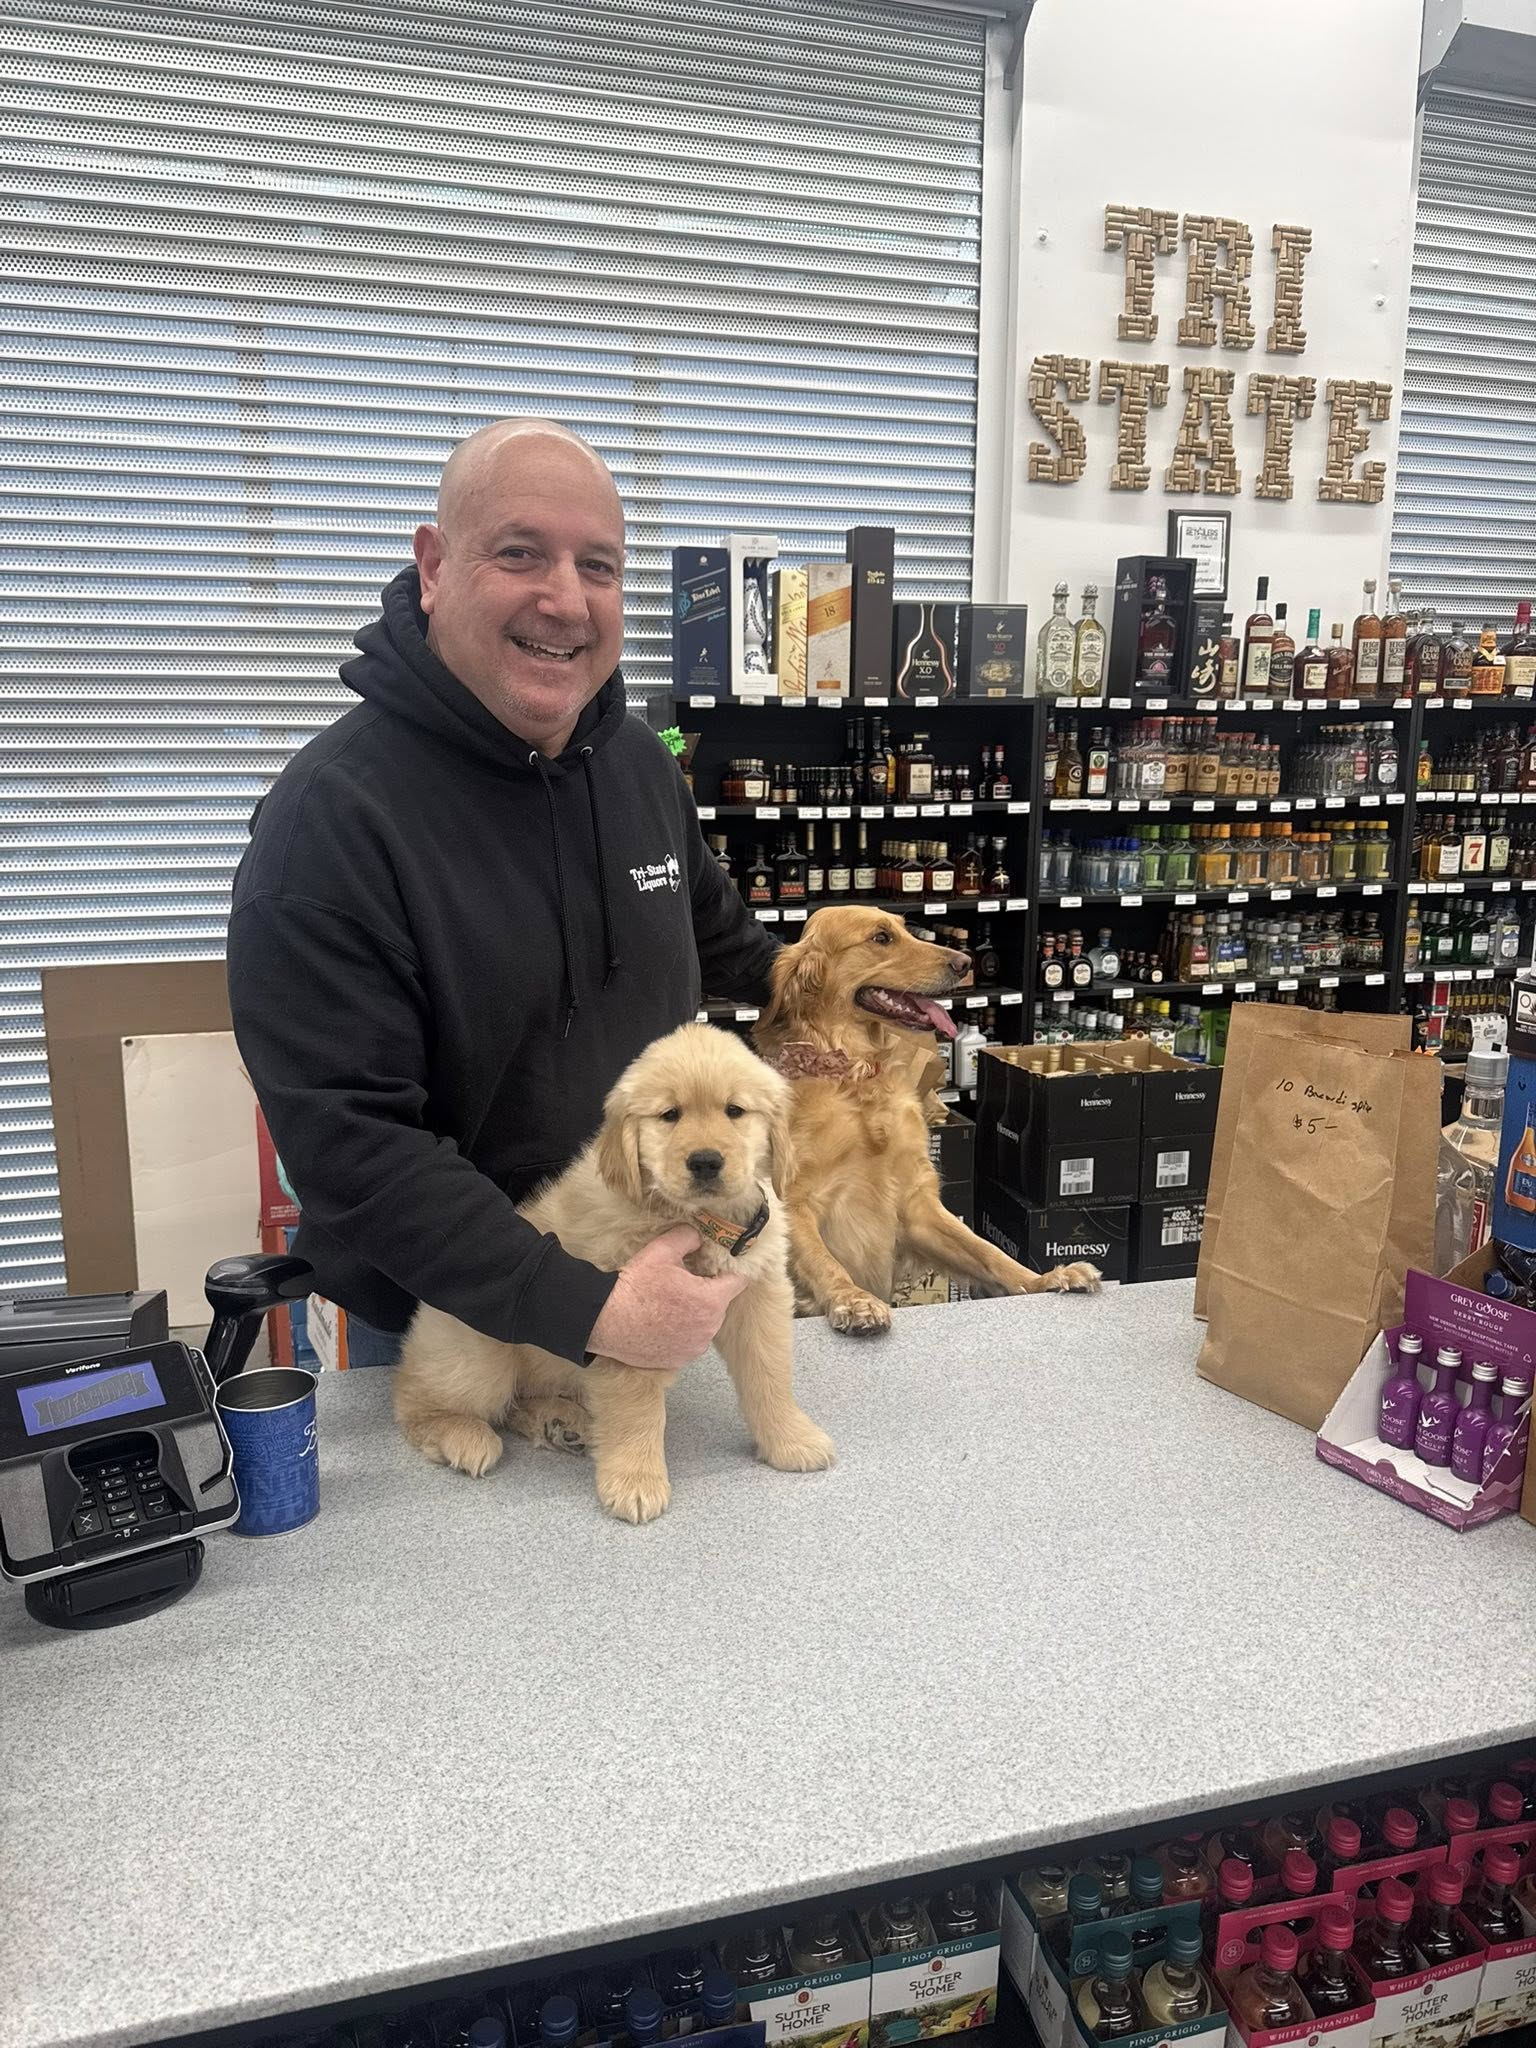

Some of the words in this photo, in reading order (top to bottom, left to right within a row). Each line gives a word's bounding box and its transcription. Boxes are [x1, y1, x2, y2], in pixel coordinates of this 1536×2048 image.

[1103, 203, 1312, 354] TRI
[1027, 354, 1393, 502] STATE
[824, 605, 836, 618] 18
[911, 658, 940, 667] Hennessy
[1469, 842, 1483, 864] 7
[629, 864, 667, 881] Tri-State
[636, 876, 668, 892] Liquors
[1275, 1078, 1294, 1092] 10
[1080, 1098, 1113, 1107] Hennessy
[1175, 1091, 1206, 1101] Hennessy
[996, 1121, 1019, 1145] Hennessy
[982, 1210, 1020, 1260] Hennessy
[1046, 1240, 1111, 1257] Hennessy
[1450, 1293, 1475, 1308] GREY
[1475, 1302, 1511, 1321] GOOSE
[1453, 1309, 1476, 1322] BERRY
[1479, 1320, 1504, 1333] ROUGE
[65, 1362, 101, 1375] Verifone
[54, 1374, 133, 1421] WELCOME
[1422, 1431, 1450, 1443] GOOSE
[902, 1951, 933, 1964] PINOT
[936, 1942, 973, 1955] GRIGIO
[1505, 1942, 1534, 1955] WHITE
[767, 1982, 799, 1995] PINOT
[804, 1972, 842, 1987] GRIGIO
[909, 1971, 962, 1992] SUTTER
[1389, 1979, 1418, 1992] WHITE
[1422, 1961, 1471, 1982] ZINFANDEL
[915, 1981, 956, 2000] HOME
[775, 2003, 831, 2024] SUTTER
[1401, 1994, 1449, 2016] SUTTER
[1405, 2005, 1442, 2023] HOME
[782, 2013, 825, 2032] HOME
[1269, 2028, 1302, 2041] WHITE
[1306, 2013, 1361, 2033] ZINFANDEL
[1129, 2034, 1160, 2048] PINOT
[1164, 2024, 1201, 2040] GRIGIO
